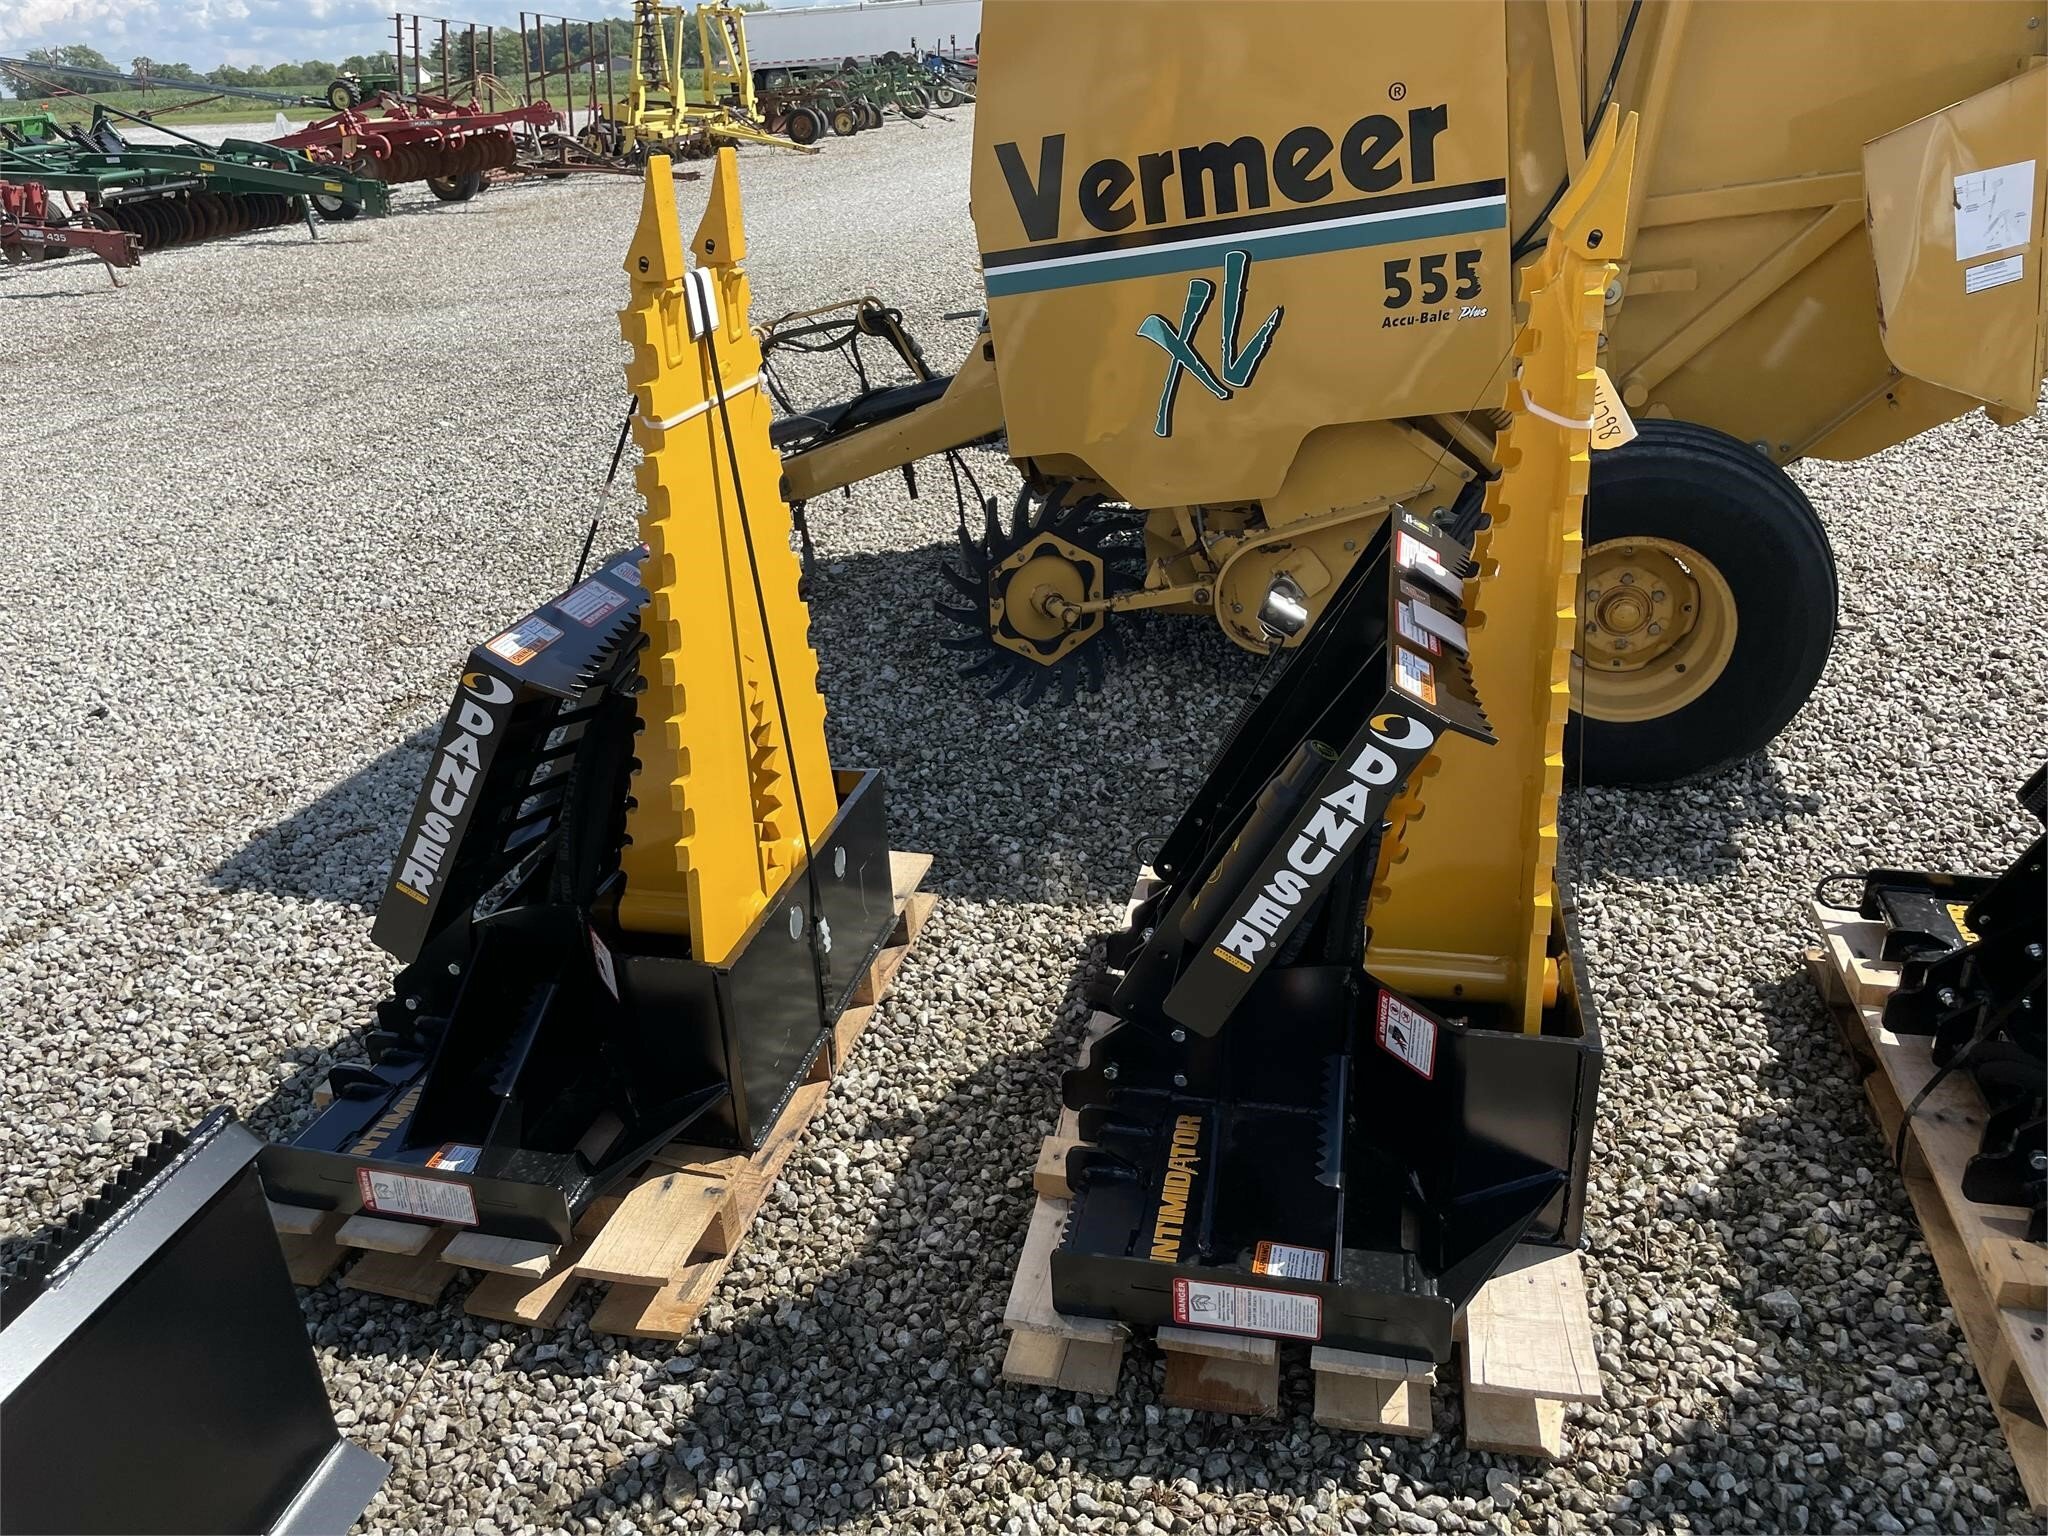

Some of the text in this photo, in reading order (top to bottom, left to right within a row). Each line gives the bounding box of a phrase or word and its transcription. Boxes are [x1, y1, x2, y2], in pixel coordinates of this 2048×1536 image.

[994, 103, 1448, 242] Vermeer
[46, 233, 67, 242] 435
[1383, 249, 1483, 309] 555
[1135, 248, 1285, 438] XL
[1381, 305, 1489, 329] Accu-Bale Plus
[400, 698, 494, 897] DANUSER
[1220, 743, 1397, 965] DANUSER
[1379, 995, 1389, 1036] DANGER
[1150, 1114, 1202, 1263] INTIMIDATOR
[1257, 1242, 1271, 1274] ARNING
[1178, 1282, 1186, 1313] DANGER
